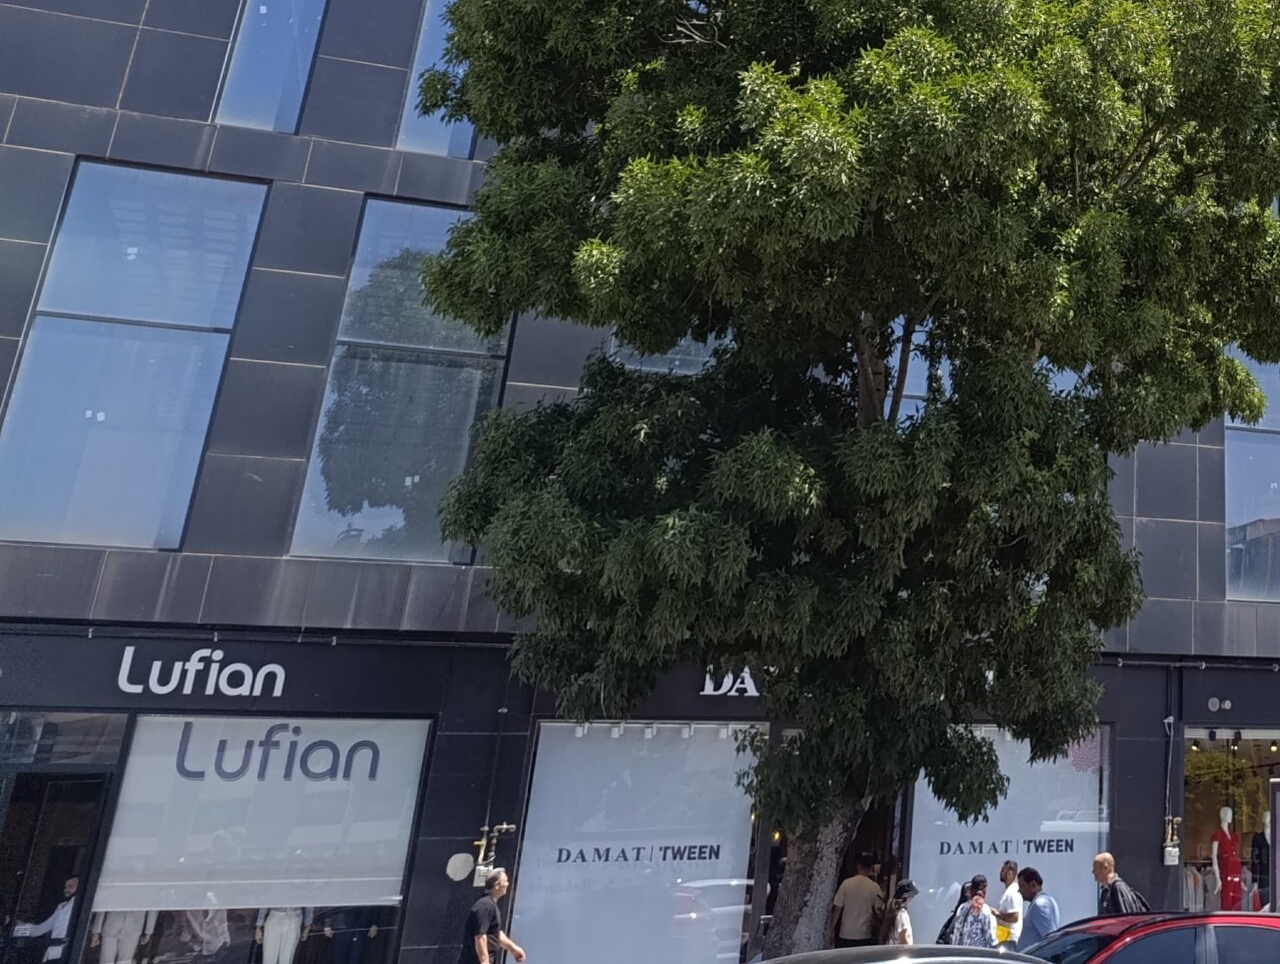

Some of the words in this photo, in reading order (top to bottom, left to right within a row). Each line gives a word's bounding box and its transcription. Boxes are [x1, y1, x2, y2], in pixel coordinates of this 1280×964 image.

[118, 646, 285, 697] Lufian
[175, 720, 380, 782] Lufian
[556, 847, 646, 863] DAMAT
[939, 840, 1013, 855] DAMAT
